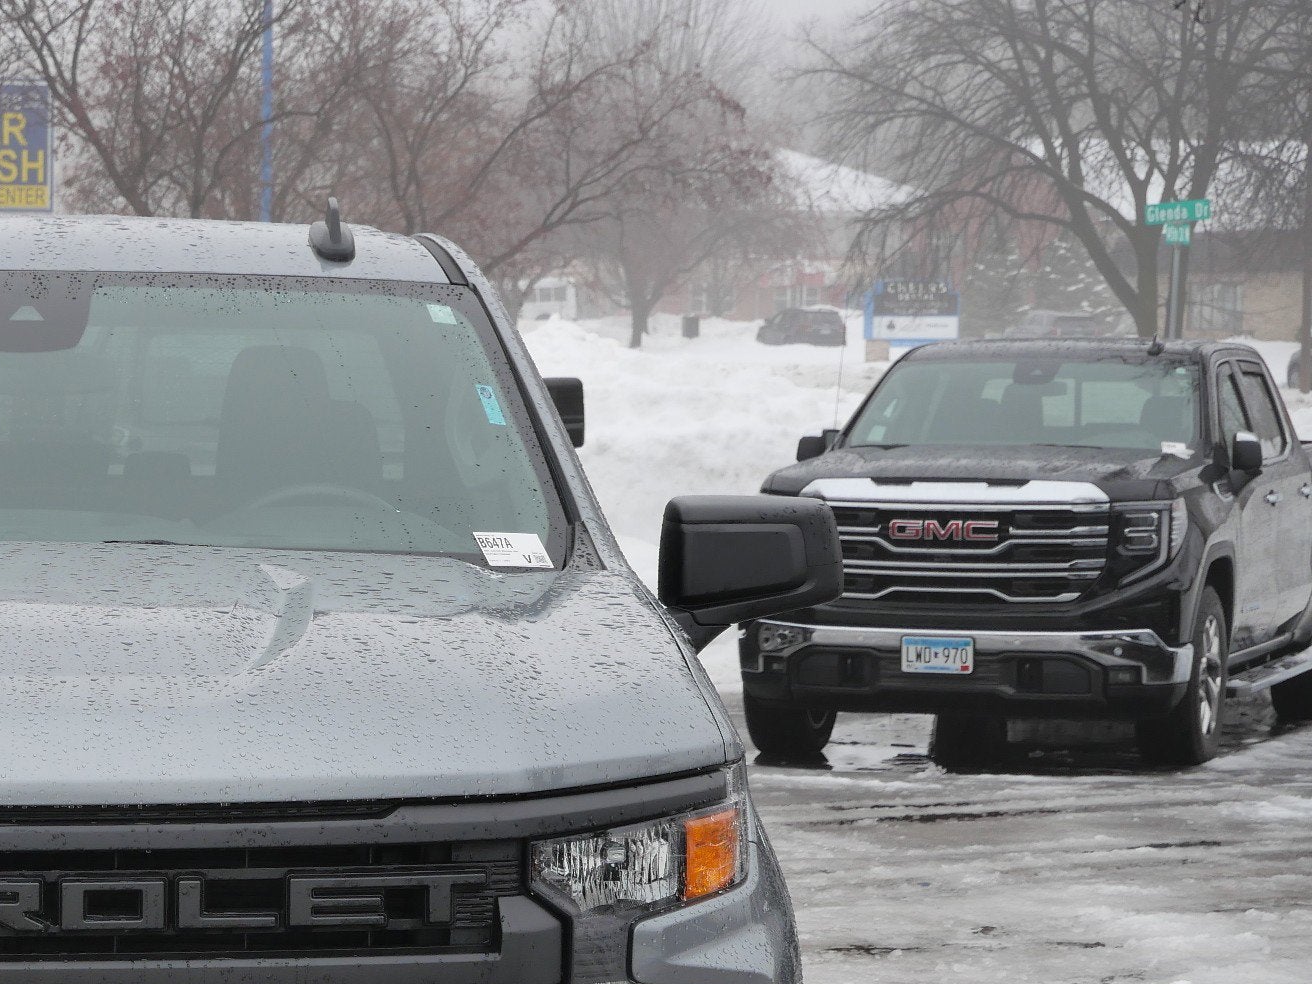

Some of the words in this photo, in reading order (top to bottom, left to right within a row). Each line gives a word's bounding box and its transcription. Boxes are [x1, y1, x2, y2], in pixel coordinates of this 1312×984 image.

[1147, 205, 1188, 223] Glenda
[1194, 202, 1209, 218] Dr
[889, 519, 998, 541] GMC
[478, 537, 513, 548] B647A
[942, 647, 968, 665] 970
